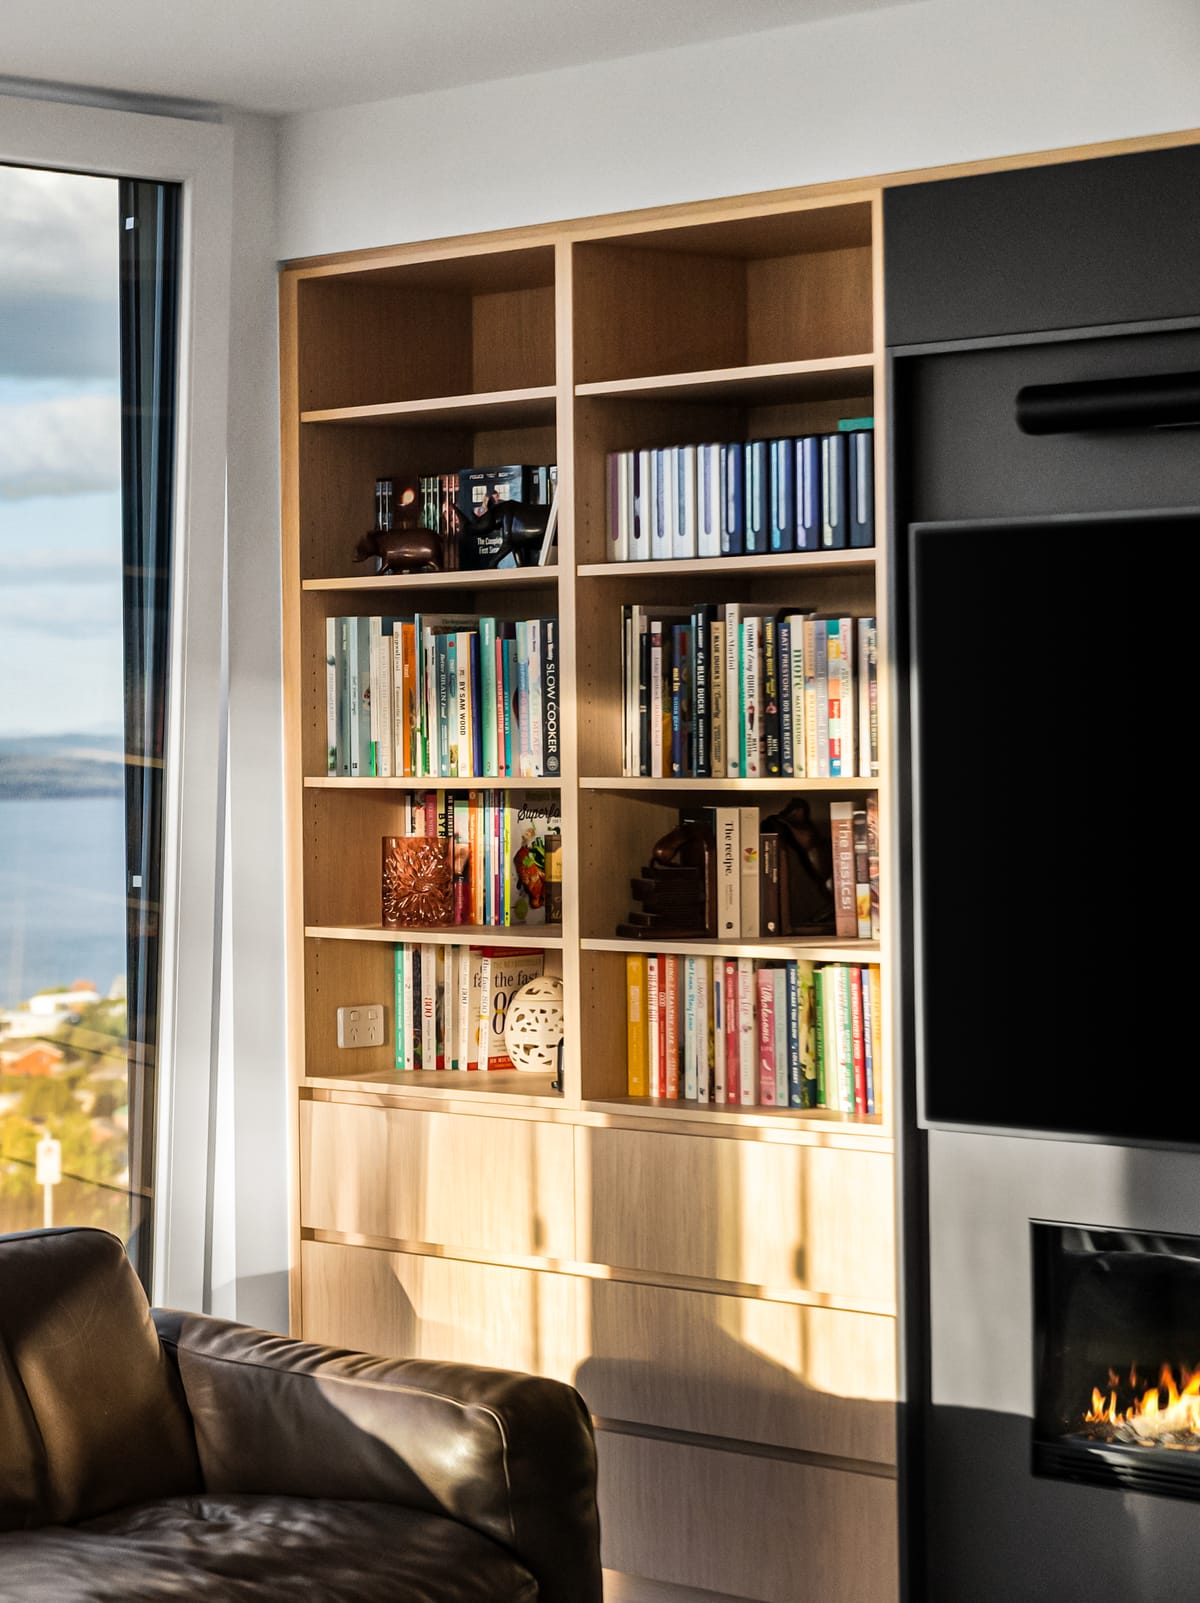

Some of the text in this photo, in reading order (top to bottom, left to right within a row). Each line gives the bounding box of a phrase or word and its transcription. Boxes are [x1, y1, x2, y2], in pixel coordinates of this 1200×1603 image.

[728, 613, 736, 639] Karen
[746, 623, 754, 652] YUMMY
[728, 641, 736, 671] Martini
[546, 663, 556, 699] SLOW
[696, 666, 705, 686] BLUE
[793, 649, 802, 690] more
[459, 682, 466, 691] BY
[746, 675, 756, 700] QUICK
[781, 628, 792, 760] MATT PRESTON'S 100 BEST RECIPES
[697, 688, 705, 714] DUCKS
[546, 702, 557, 754] COOKER
[724, 821, 735, 841] The
[838, 822, 852, 848] The
[839, 851, 853, 911] Basics:
[494, 970, 514, 988] the
[424, 997, 433, 1018] 800
[760, 985, 773, 1043] Wholesome
